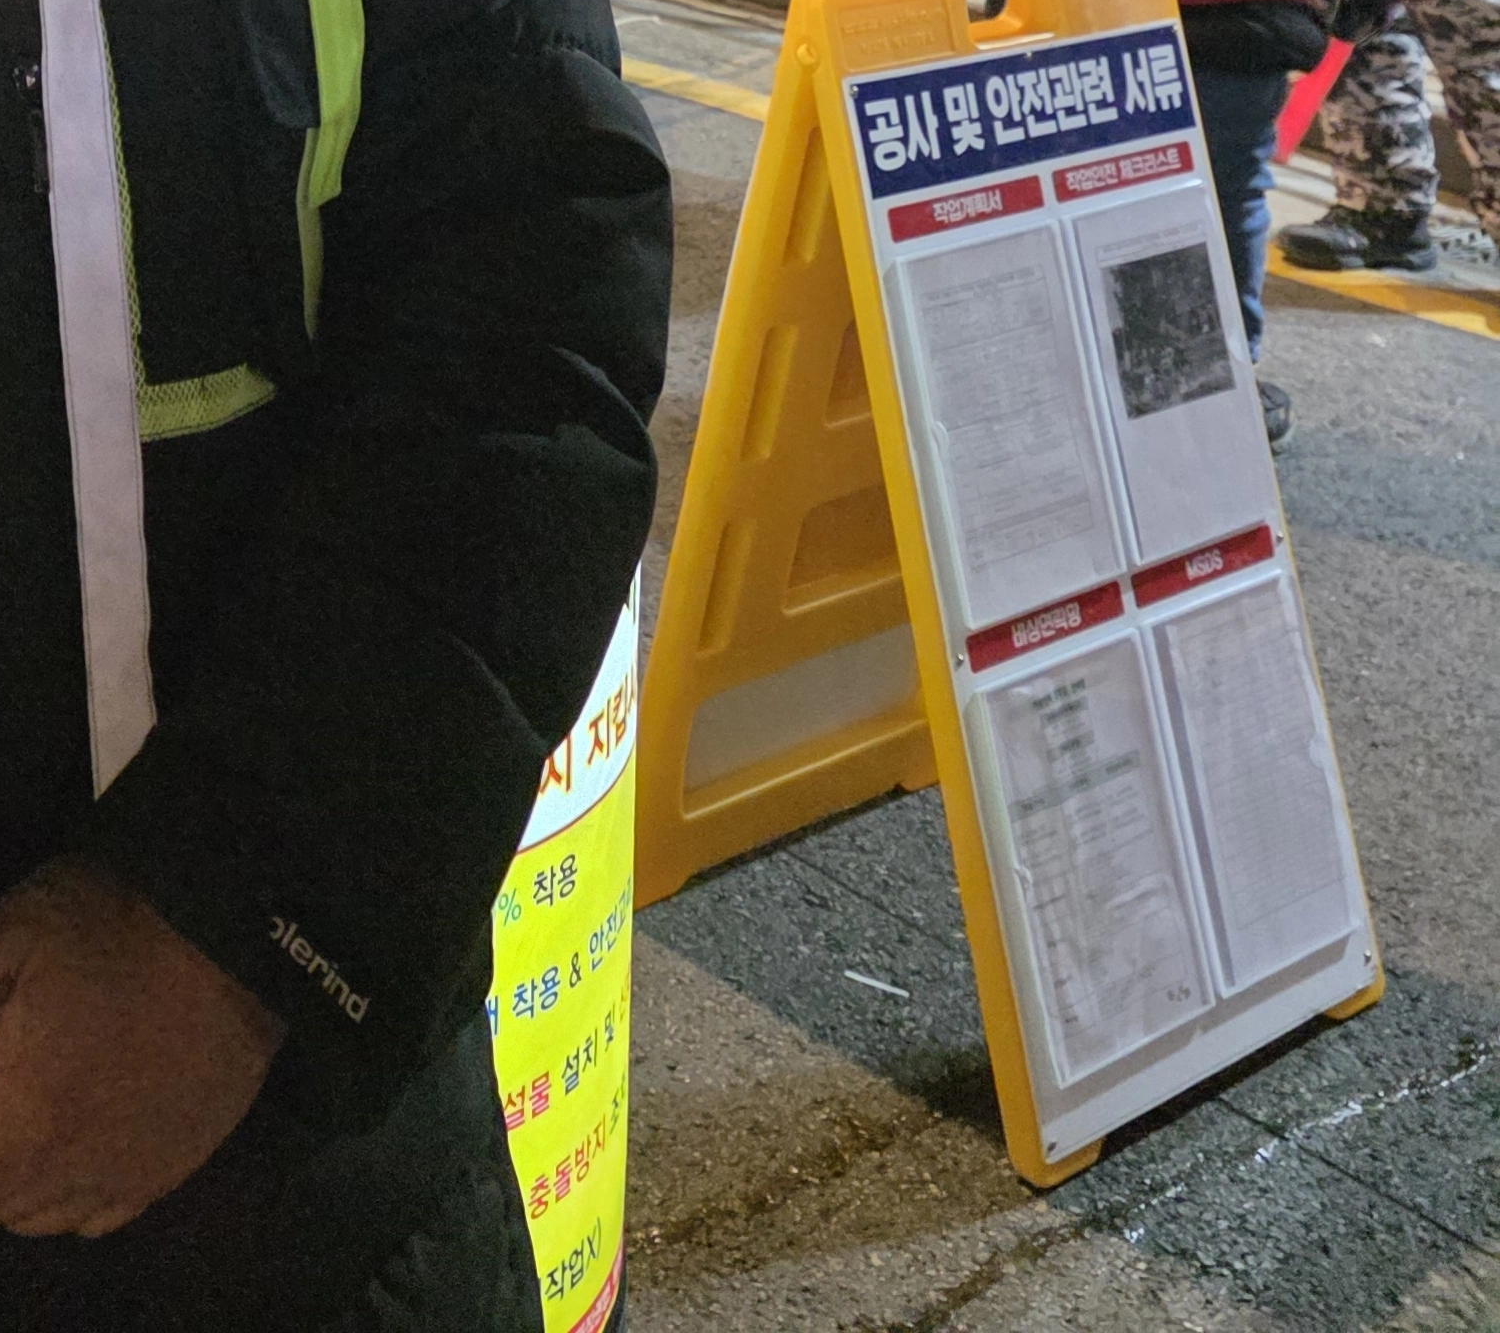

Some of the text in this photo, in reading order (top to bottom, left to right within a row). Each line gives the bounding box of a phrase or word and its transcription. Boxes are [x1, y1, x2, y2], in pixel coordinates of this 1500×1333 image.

[864, 43, 1184, 172] 공사 및 안전관련 서류
[1065, 146, 1181, 194] 작업안전 체크리스트
[931, 188, 1003, 226] 작업계획서
[1184, 546, 1224, 581] MSDS
[532, 853, 578, 907] 착용
[512, 965, 561, 1020] 착용
[569, 951, 582, 989] &
[561, 1027, 598, 1097] 설치
[604, 1002, 615, 1053] 및
[528, 1113, 606, 1220] 충돌방지
